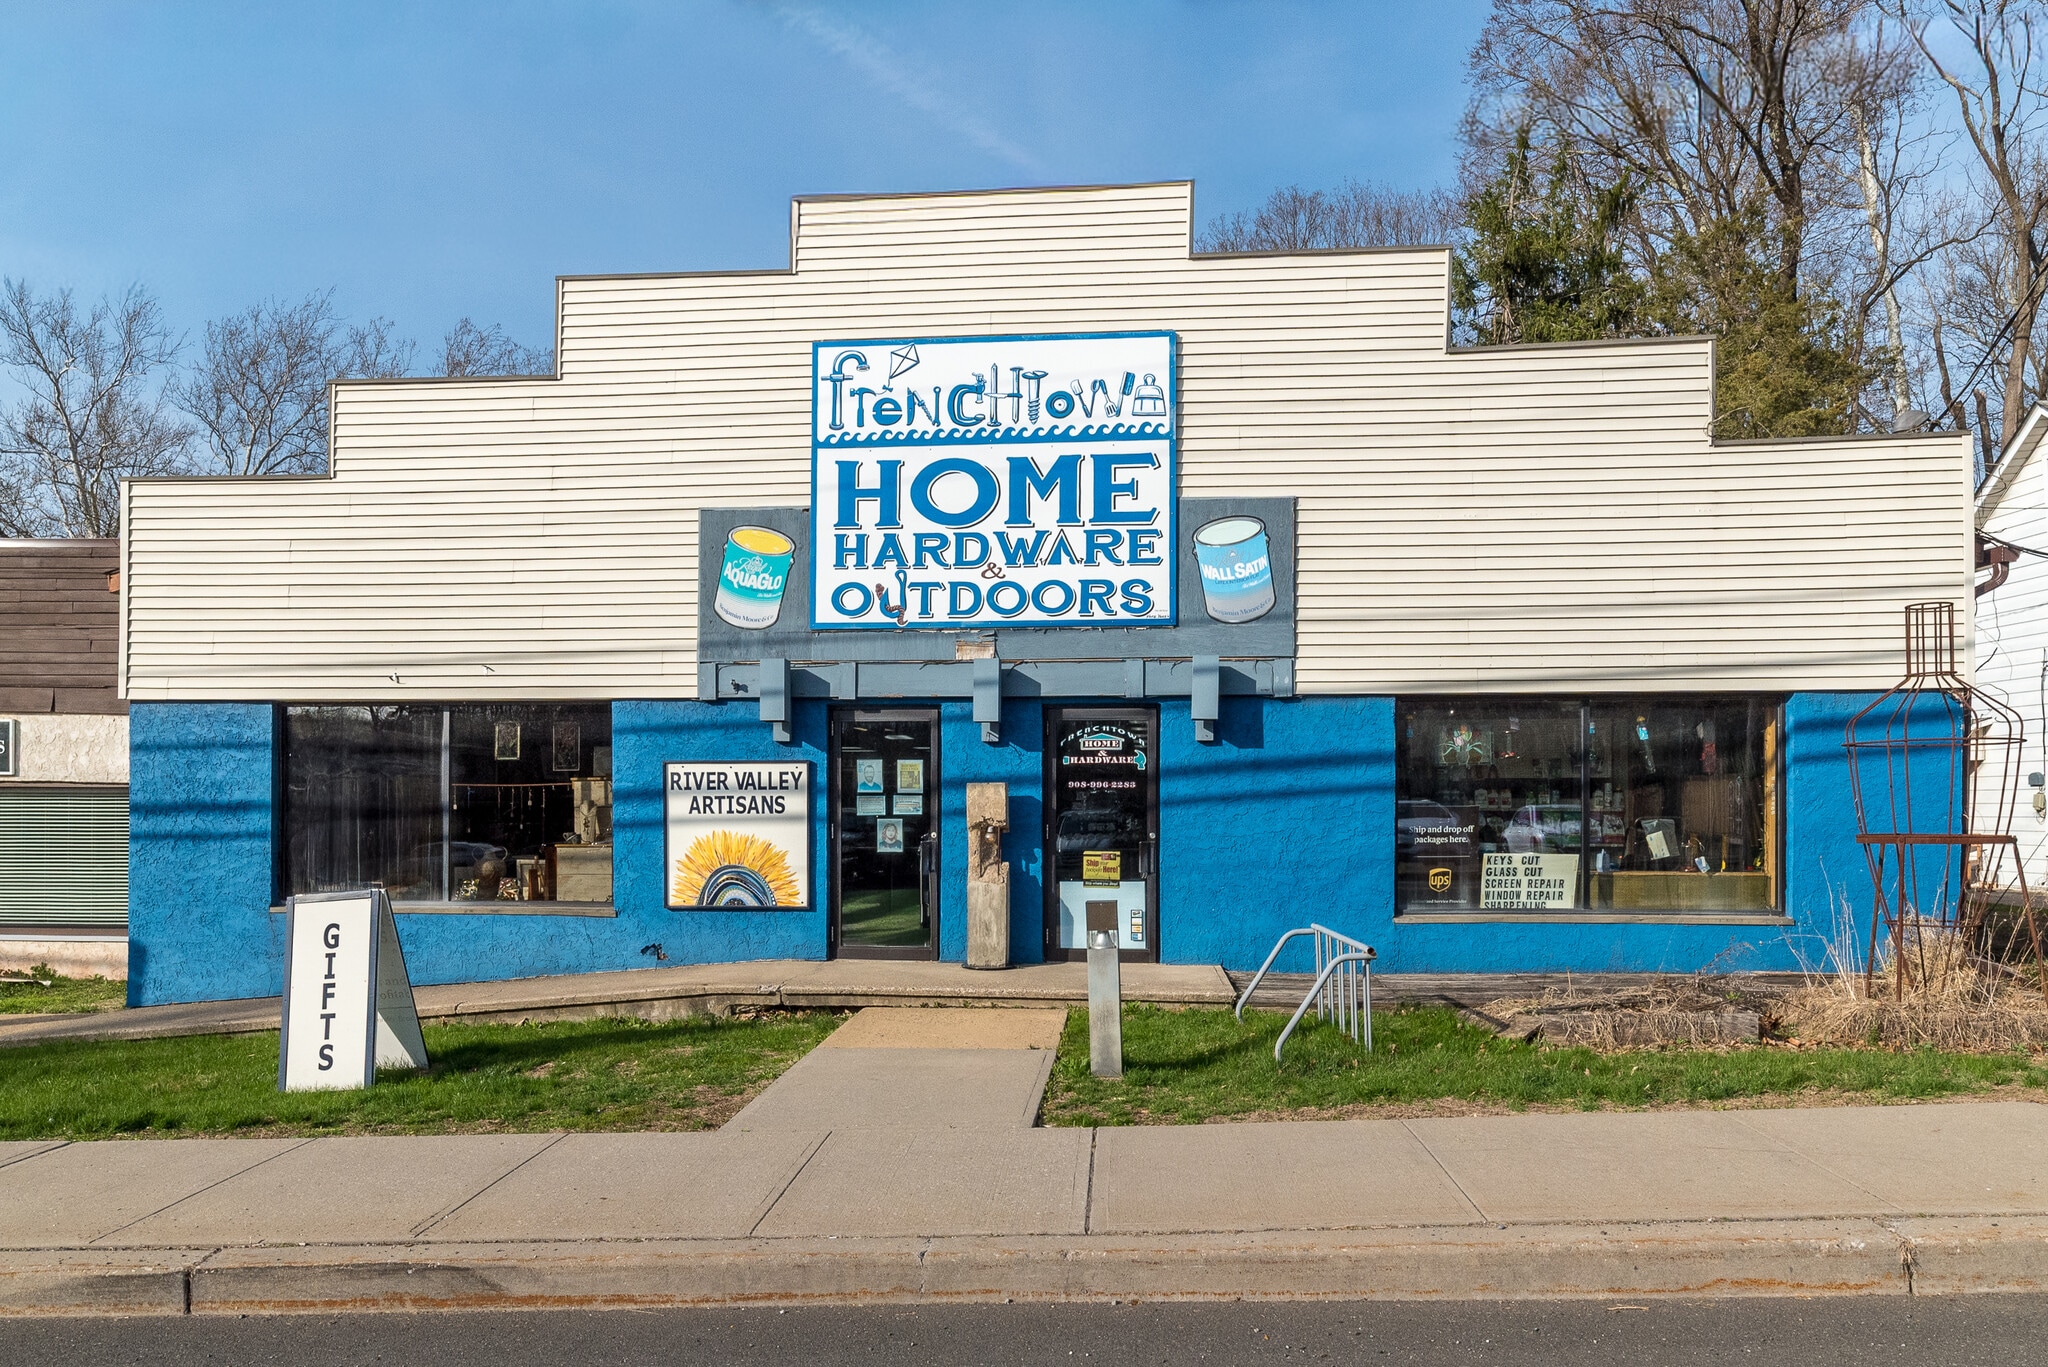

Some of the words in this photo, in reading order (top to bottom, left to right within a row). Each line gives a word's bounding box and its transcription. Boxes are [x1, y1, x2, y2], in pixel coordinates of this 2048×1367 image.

[833, 451, 1163, 530] HOME
[833, 528, 1164, 571] HARDWARE
[981, 561, 1006, 580] &
[1201, 563, 1235, 580] WALL
[1234, 554, 1267, 579] SATIN
[723, 562, 783, 590] AQUAGLO
[831, 569, 1155, 626] OUTDOORS
[1070, 756, 1134, 764] HARDWARE
[670, 771, 729, 791] RIVER
[735, 771, 803, 790] VALLEY
[688, 795, 786, 814] ARTISANS
[1409, 825, 1427, 835] Ship
[1427, 825, 1442, 833] and
[1443, 825, 1462, 835] drop
[1463, 825, 1475, 833] off
[1414, 836, 1449, 845] packages
[1449, 835, 1469, 843] here.
[1086, 859, 1099, 867] Ship
[1486, 855, 1513, 865] KEYS
[1521, 855, 1540, 865] CUT
[1102, 865, 1118, 873] Here!
[1485, 867, 1518, 877] GLASS
[1524, 867, 1543, 877] CUT
[1431, 875, 1449, 889] ups
[1485, 879, 1522, 888] SCREEN
[1527, 879, 1564, 888] REPAIR
[1484, 890, 1522, 901] WINDOW
[1526, 890, 1564, 901] REPAIR
[318, 923, 341, 1071] GIFTS
